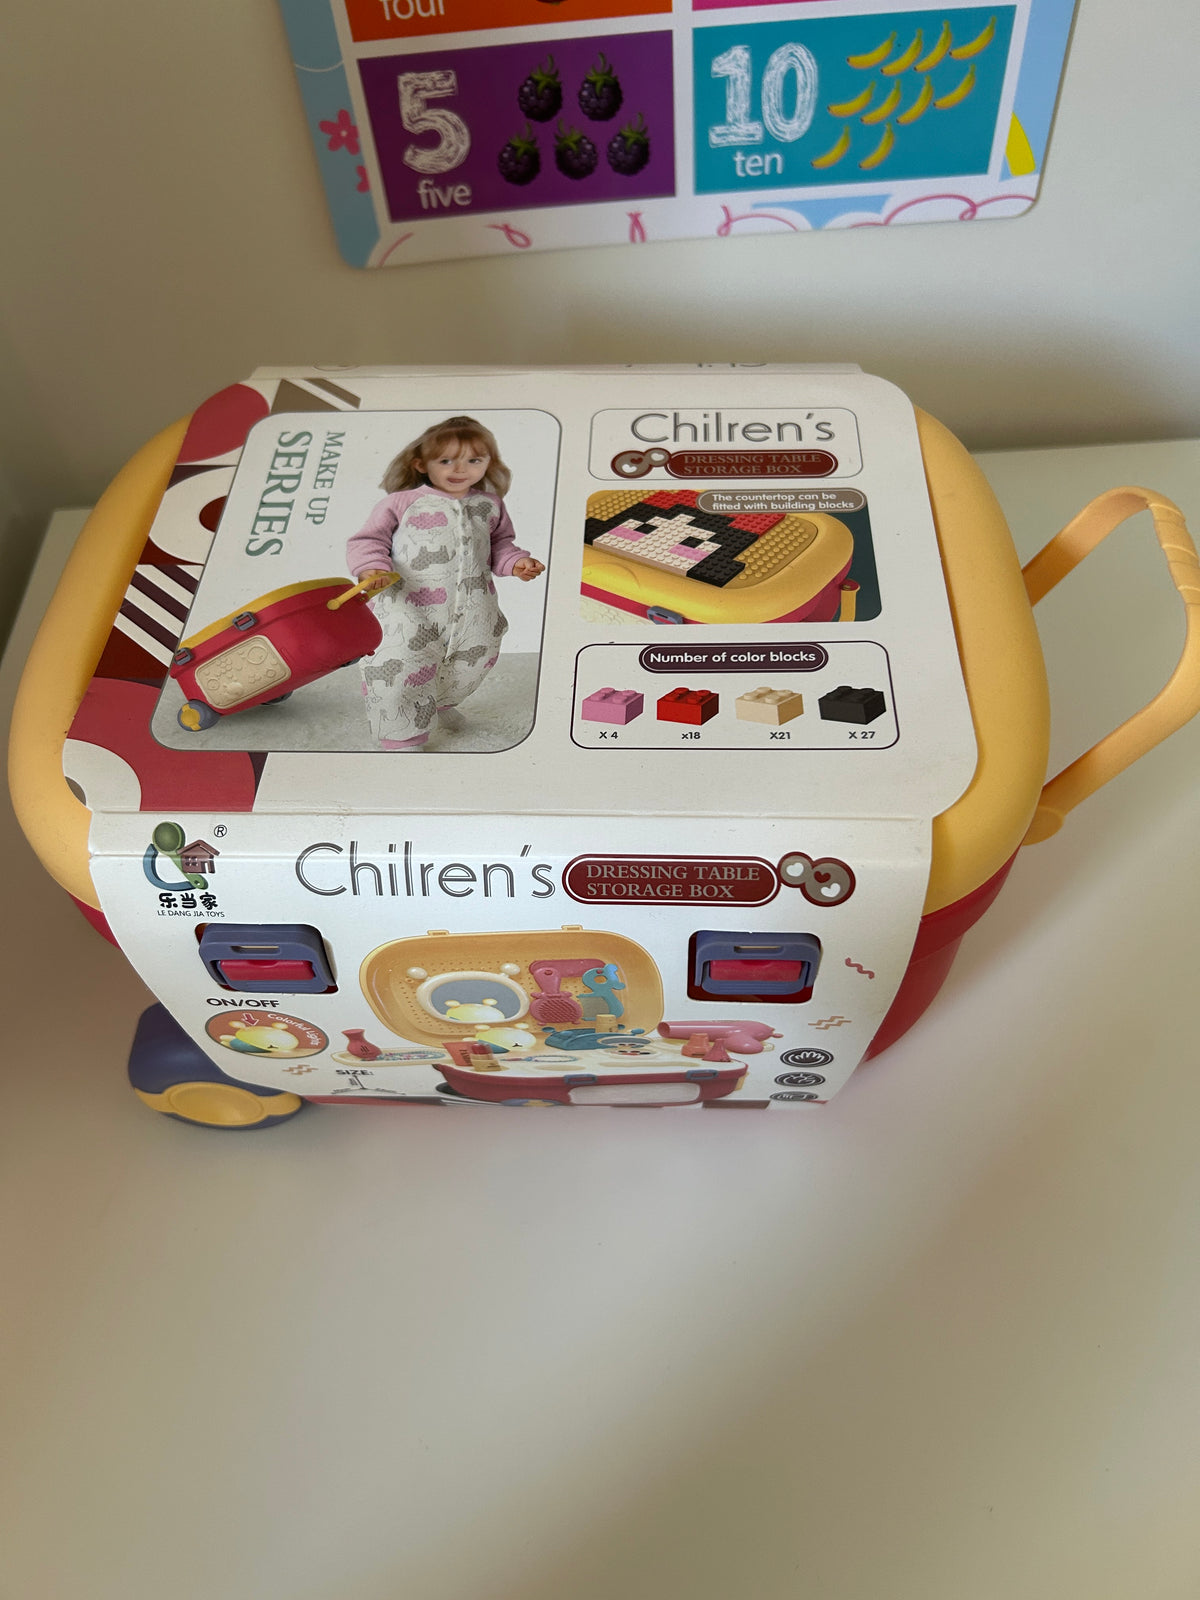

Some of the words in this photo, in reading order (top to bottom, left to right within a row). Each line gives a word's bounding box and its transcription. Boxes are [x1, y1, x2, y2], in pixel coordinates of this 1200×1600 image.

[709, 42, 818, 147] 10
[397, 70, 471, 174] 5
[733, 149, 783, 177] ten
[417, 179, 472, 209] five
[630, 412, 835, 443] Chilren's
[313, 430, 346, 490] MAKE
[684, 454, 764, 464] DRESSING
[768, 454, 822, 463] TABLE
[683, 465, 762, 475] STORAGE
[766, 465, 802, 474] BOX
[245, 431, 313, 557] SERIES
[712, 493, 733, 502] The
[735, 494, 798, 504] countertop
[821, 492, 837, 500] be
[304, 496, 330, 525] UP
[712, 502, 741, 511] fitted
[743, 502, 769, 510] with
[771, 501, 817, 511] building
[818, 501, 855, 510] blocks
[650, 652, 708, 663] Number
[711, 651, 727, 663] of
[730, 651, 767, 662] color
[770, 651, 817, 662] blocks
[599, 731, 608, 740] X
[610, 731, 619, 740] 4
[681, 731, 701, 740] x18
[770, 731, 791, 740] X21
[848, 731, 858, 740] X
[861, 731, 876, 740] 27
[295, 840, 556, 899] Chilren's
[586, 864, 688, 880] DRESSING
[695, 866, 760, 881] TABLE
[587, 882, 683, 897] STORAGE
[689, 884, 735, 898] BOX
[159, 892, 218, 910] 乐当家
[205, 910, 225, 918] TOYS
[206, 998, 280, 1007] ON/OFF
[267, 1013, 312, 1031] Colorful
